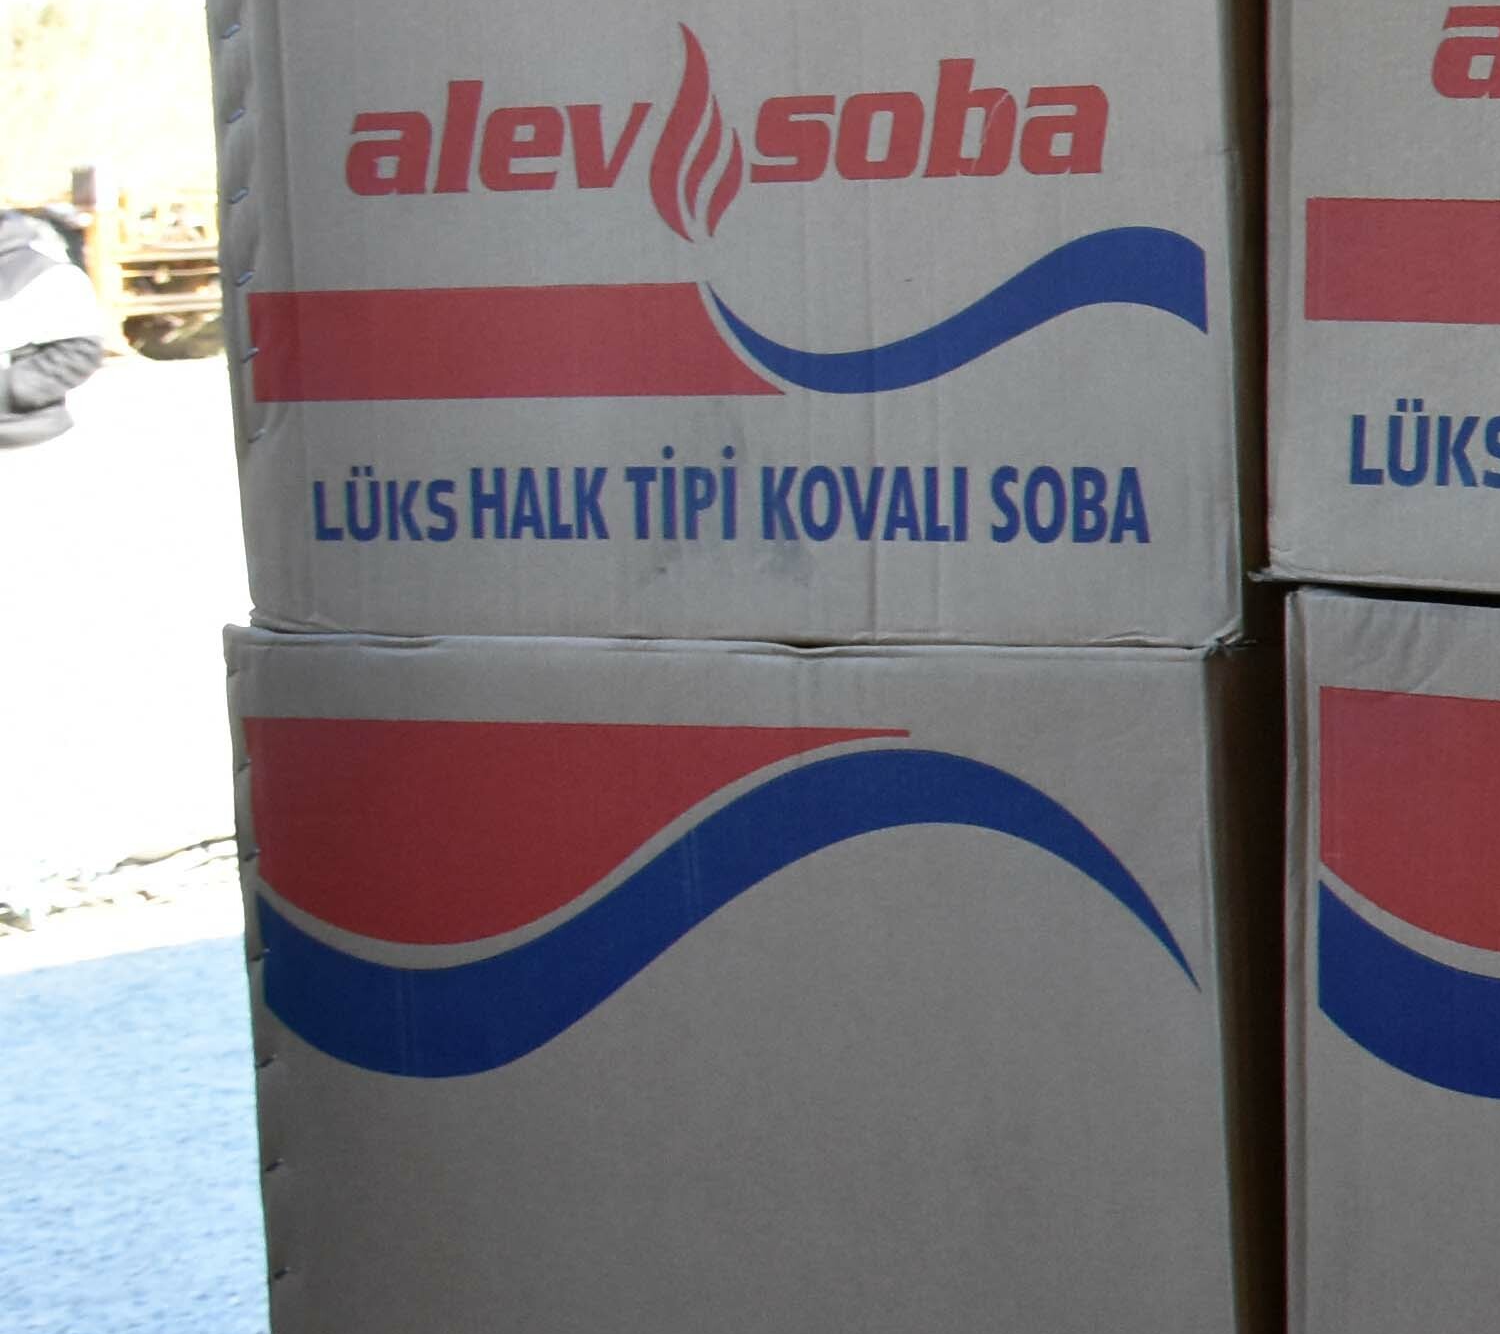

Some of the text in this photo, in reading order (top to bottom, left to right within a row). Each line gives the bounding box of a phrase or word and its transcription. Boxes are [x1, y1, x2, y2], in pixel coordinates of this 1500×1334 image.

[345, 58, 1110, 196] alev soba
[314, 445, 1151, 545] LÜKS HALK TİPİ KOVALI SOBA
